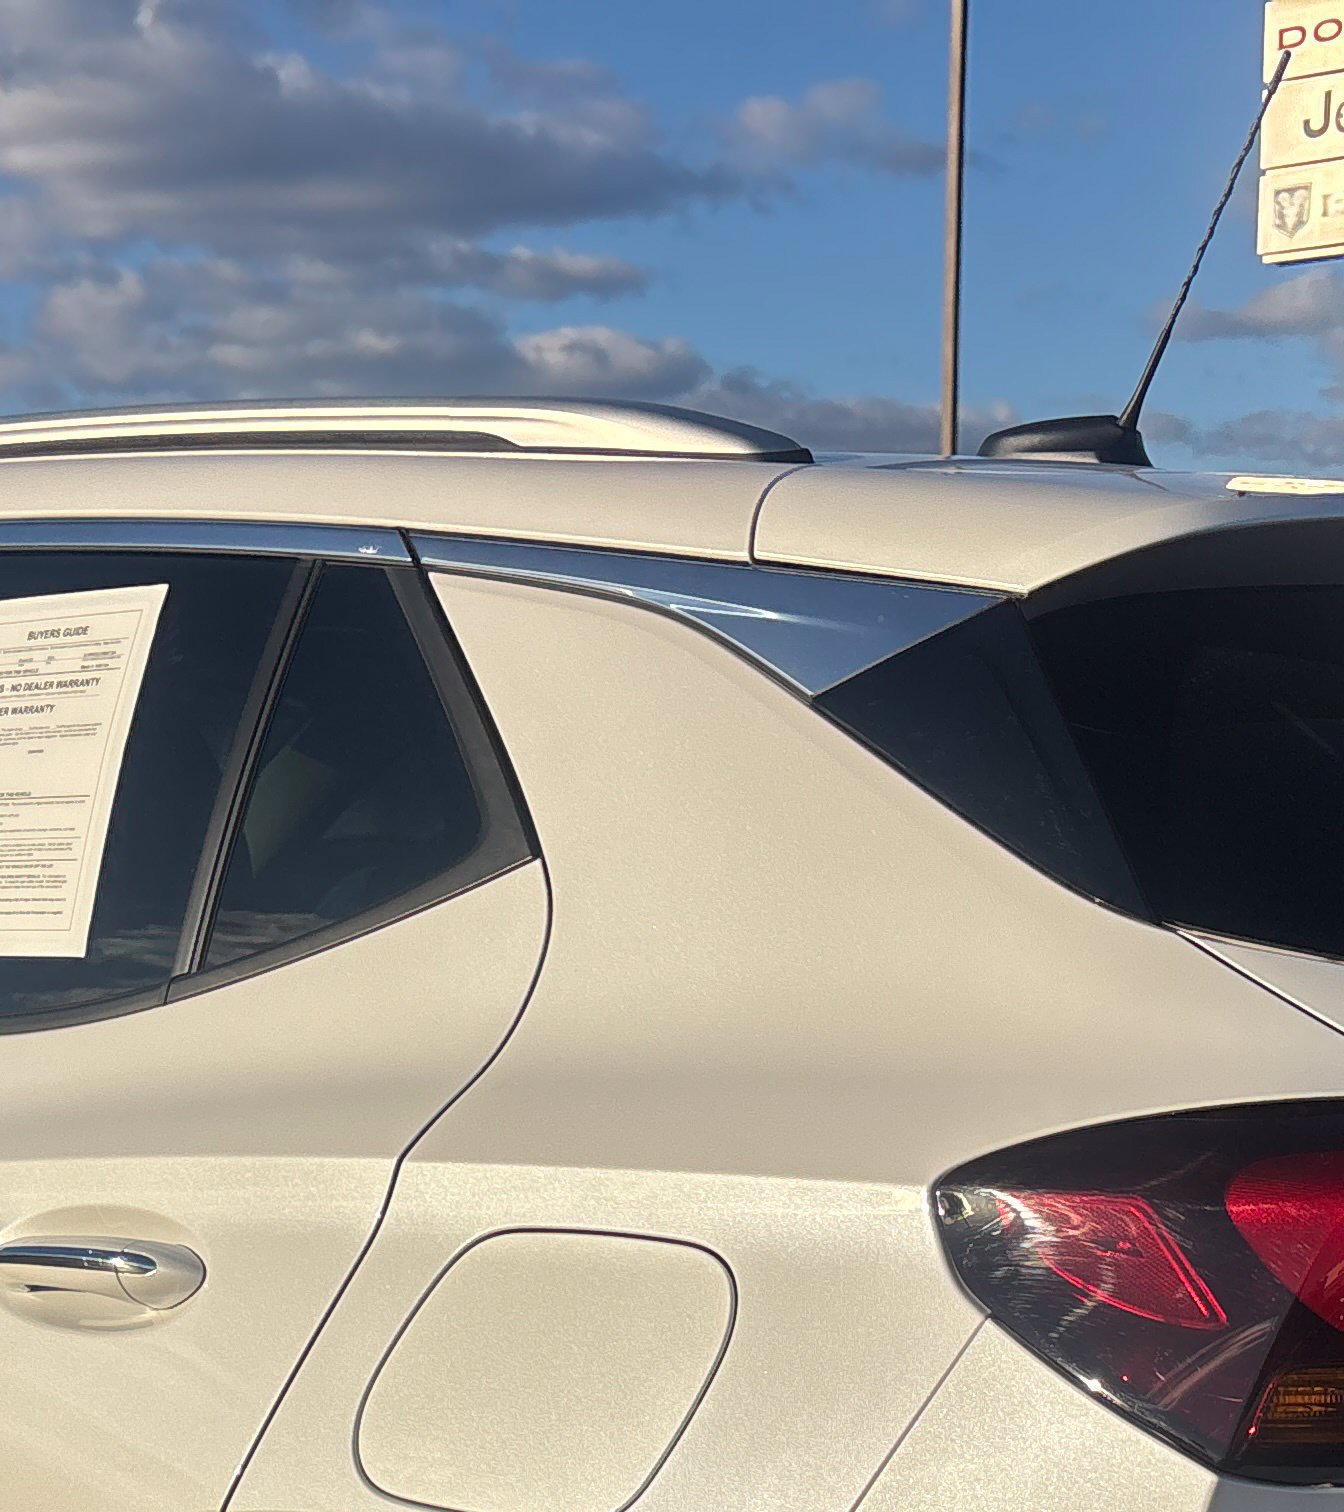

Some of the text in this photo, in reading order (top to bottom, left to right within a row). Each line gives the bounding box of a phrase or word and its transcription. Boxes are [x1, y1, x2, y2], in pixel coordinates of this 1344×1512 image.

[27, 625, 90, 641] BUYERS GUIDE
[10, 683, 21, 692] NO
[24, 680, 54, 692] DEALER
[55, 676, 102, 688] WARRANTY
[10, 703, 56, 715] WARRANTY
